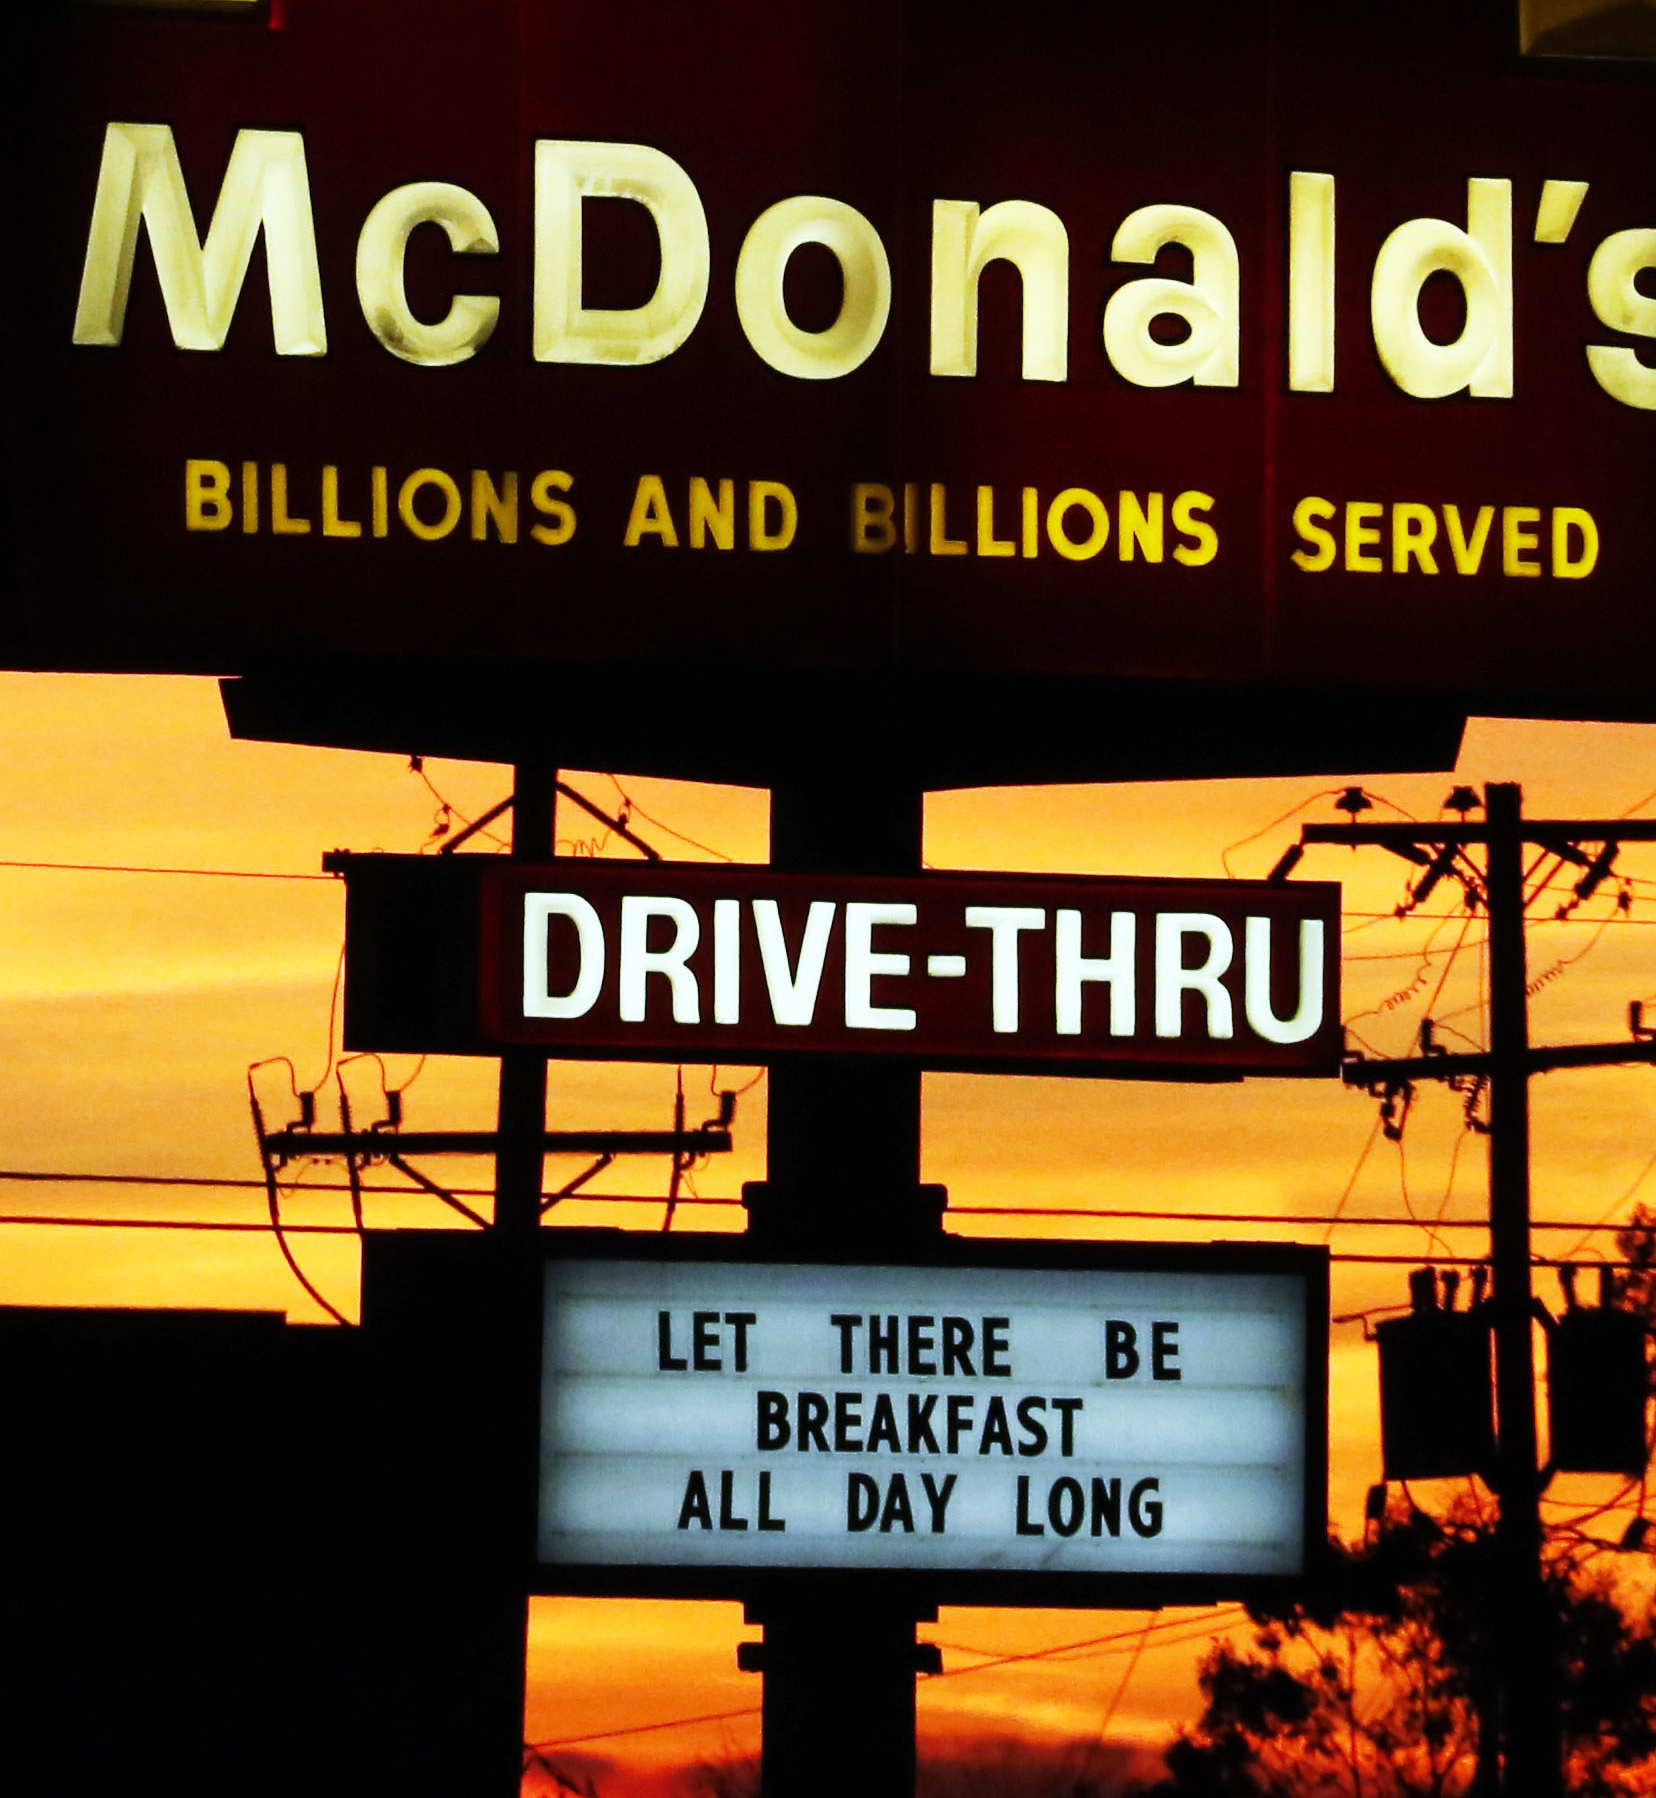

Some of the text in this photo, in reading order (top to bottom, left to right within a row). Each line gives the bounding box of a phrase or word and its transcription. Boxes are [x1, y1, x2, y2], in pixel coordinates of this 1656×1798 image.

[185, 458, 1601, 580] BILLIONS AND BILLIONS SERVED
[522, 892, 1325, 1044] DRIVE-THRU
[658, 1310, 1182, 1381] LET THERE BE
[757, 1390, 1083, 1457] BREAKFAST
[677, 1470, 1163, 1538] ALL DAY LONG
